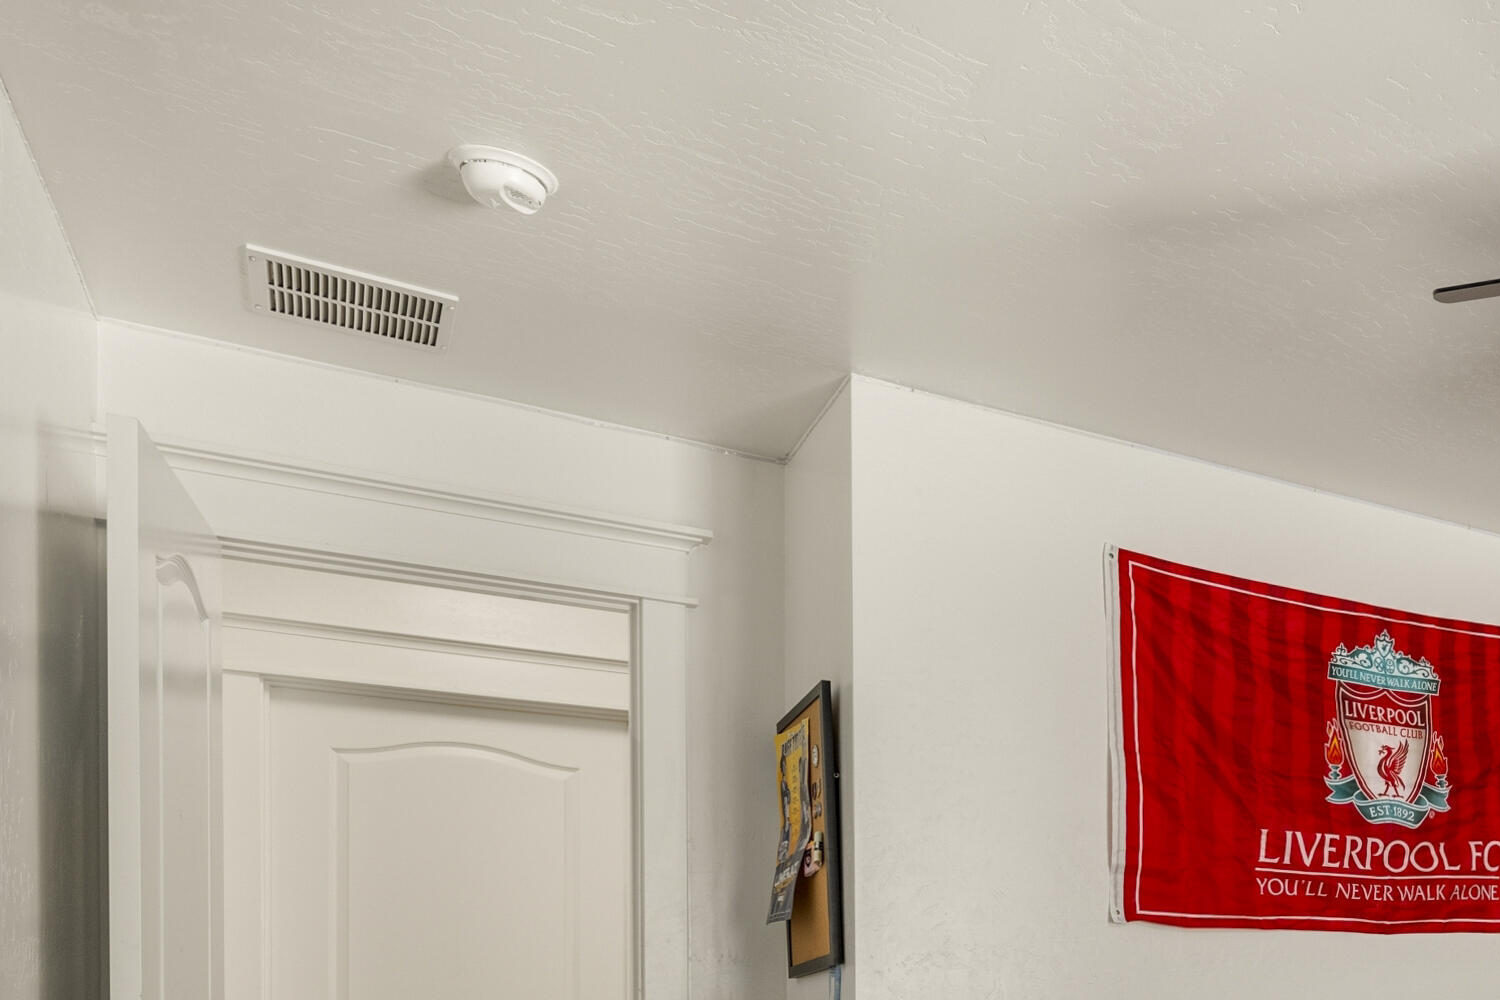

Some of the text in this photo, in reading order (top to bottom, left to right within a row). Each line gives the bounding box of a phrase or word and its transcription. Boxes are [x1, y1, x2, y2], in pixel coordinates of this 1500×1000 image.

[1331, 666, 1437, 692] YOU'LL NEVER WALK ALONE
[1344, 700, 1425, 727] LIVERPOOL
[1349, 721, 1423, 740] FOOTBALL CLUB
[1257, 828, 1461, 873] LIVERPOOL
[1256, 877, 1500, 901] YOU'LL NEVER WALK ALONE
